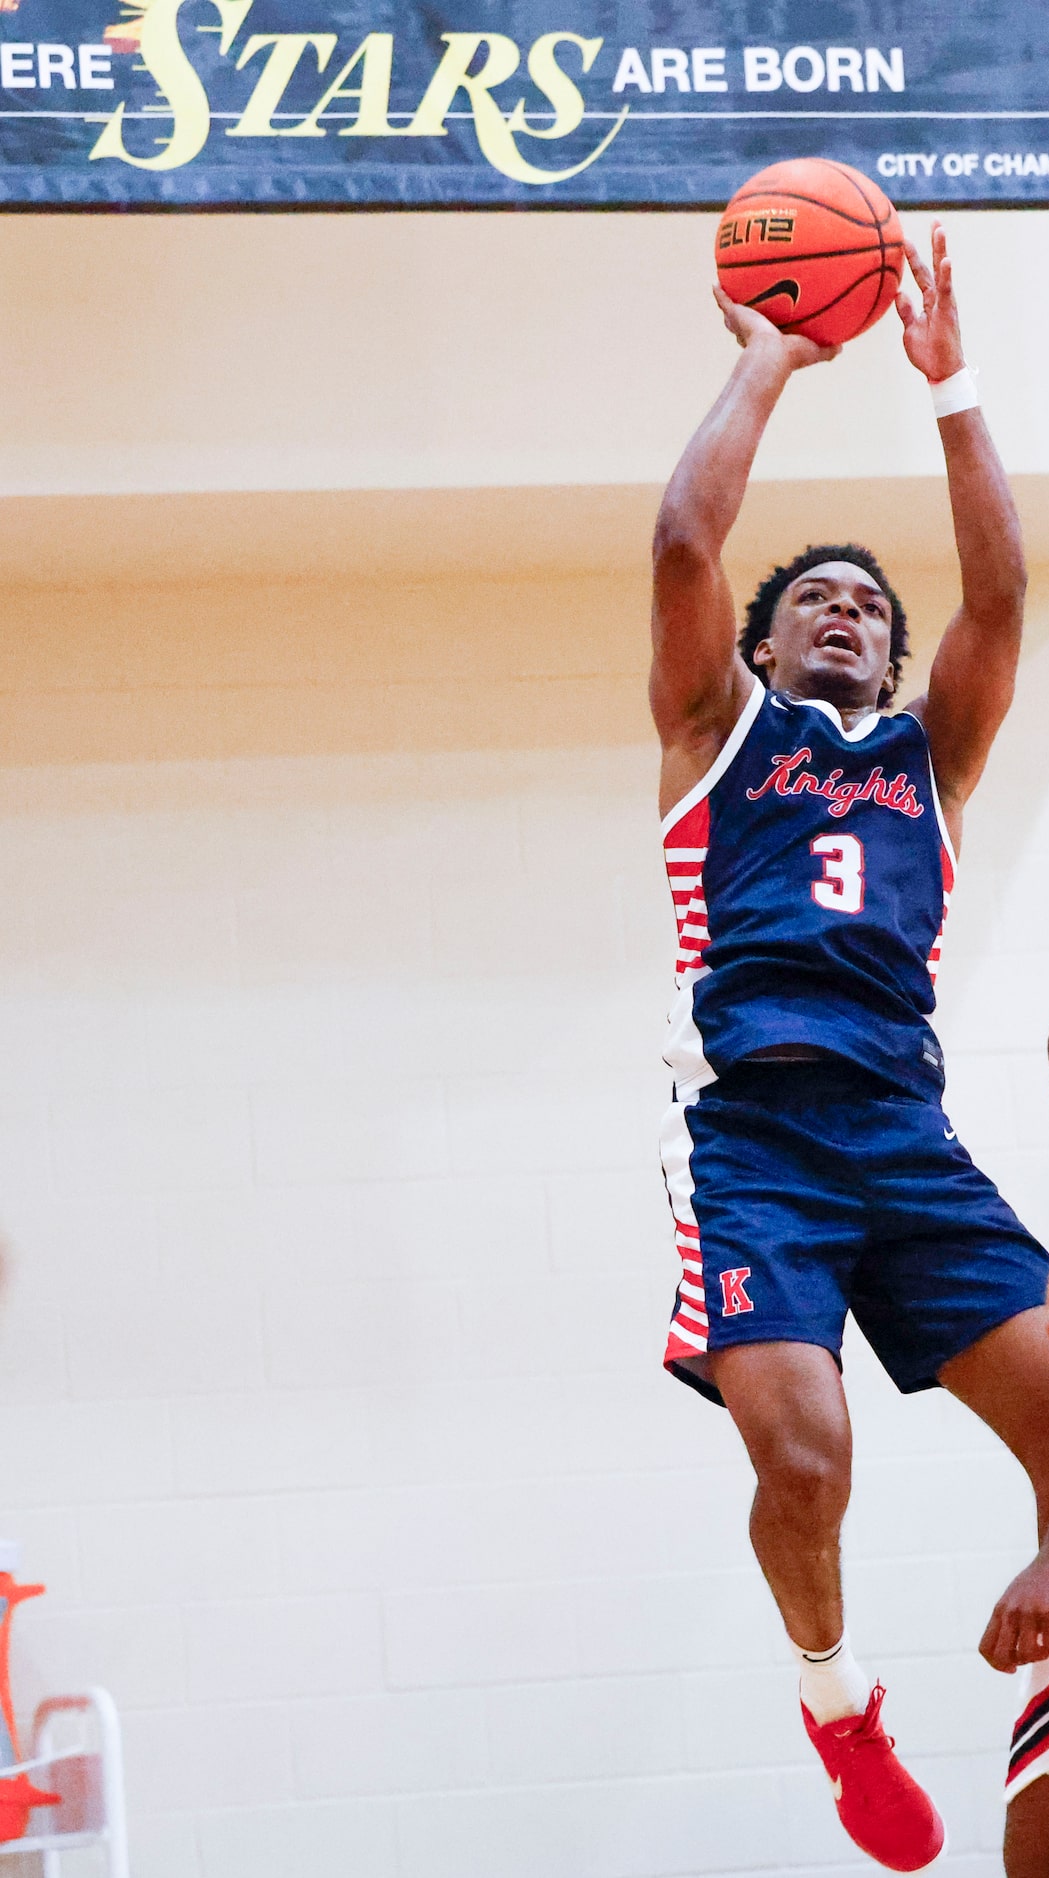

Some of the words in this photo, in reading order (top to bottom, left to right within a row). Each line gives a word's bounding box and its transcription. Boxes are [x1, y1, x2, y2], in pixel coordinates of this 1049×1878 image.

[0, 42, 115, 90] ERE
[89, 0, 629, 185] STARS
[612, 47, 729, 93] ARE
[743, 45, 905, 93] BORN
[877, 153, 937, 177] CITY
[942, 153, 979, 177] OF
[719, 218, 795, 250] ELITE
[746, 747, 925, 818] Knights
[810, 832, 866, 915] 3
[719, 1266, 755, 1317] K
